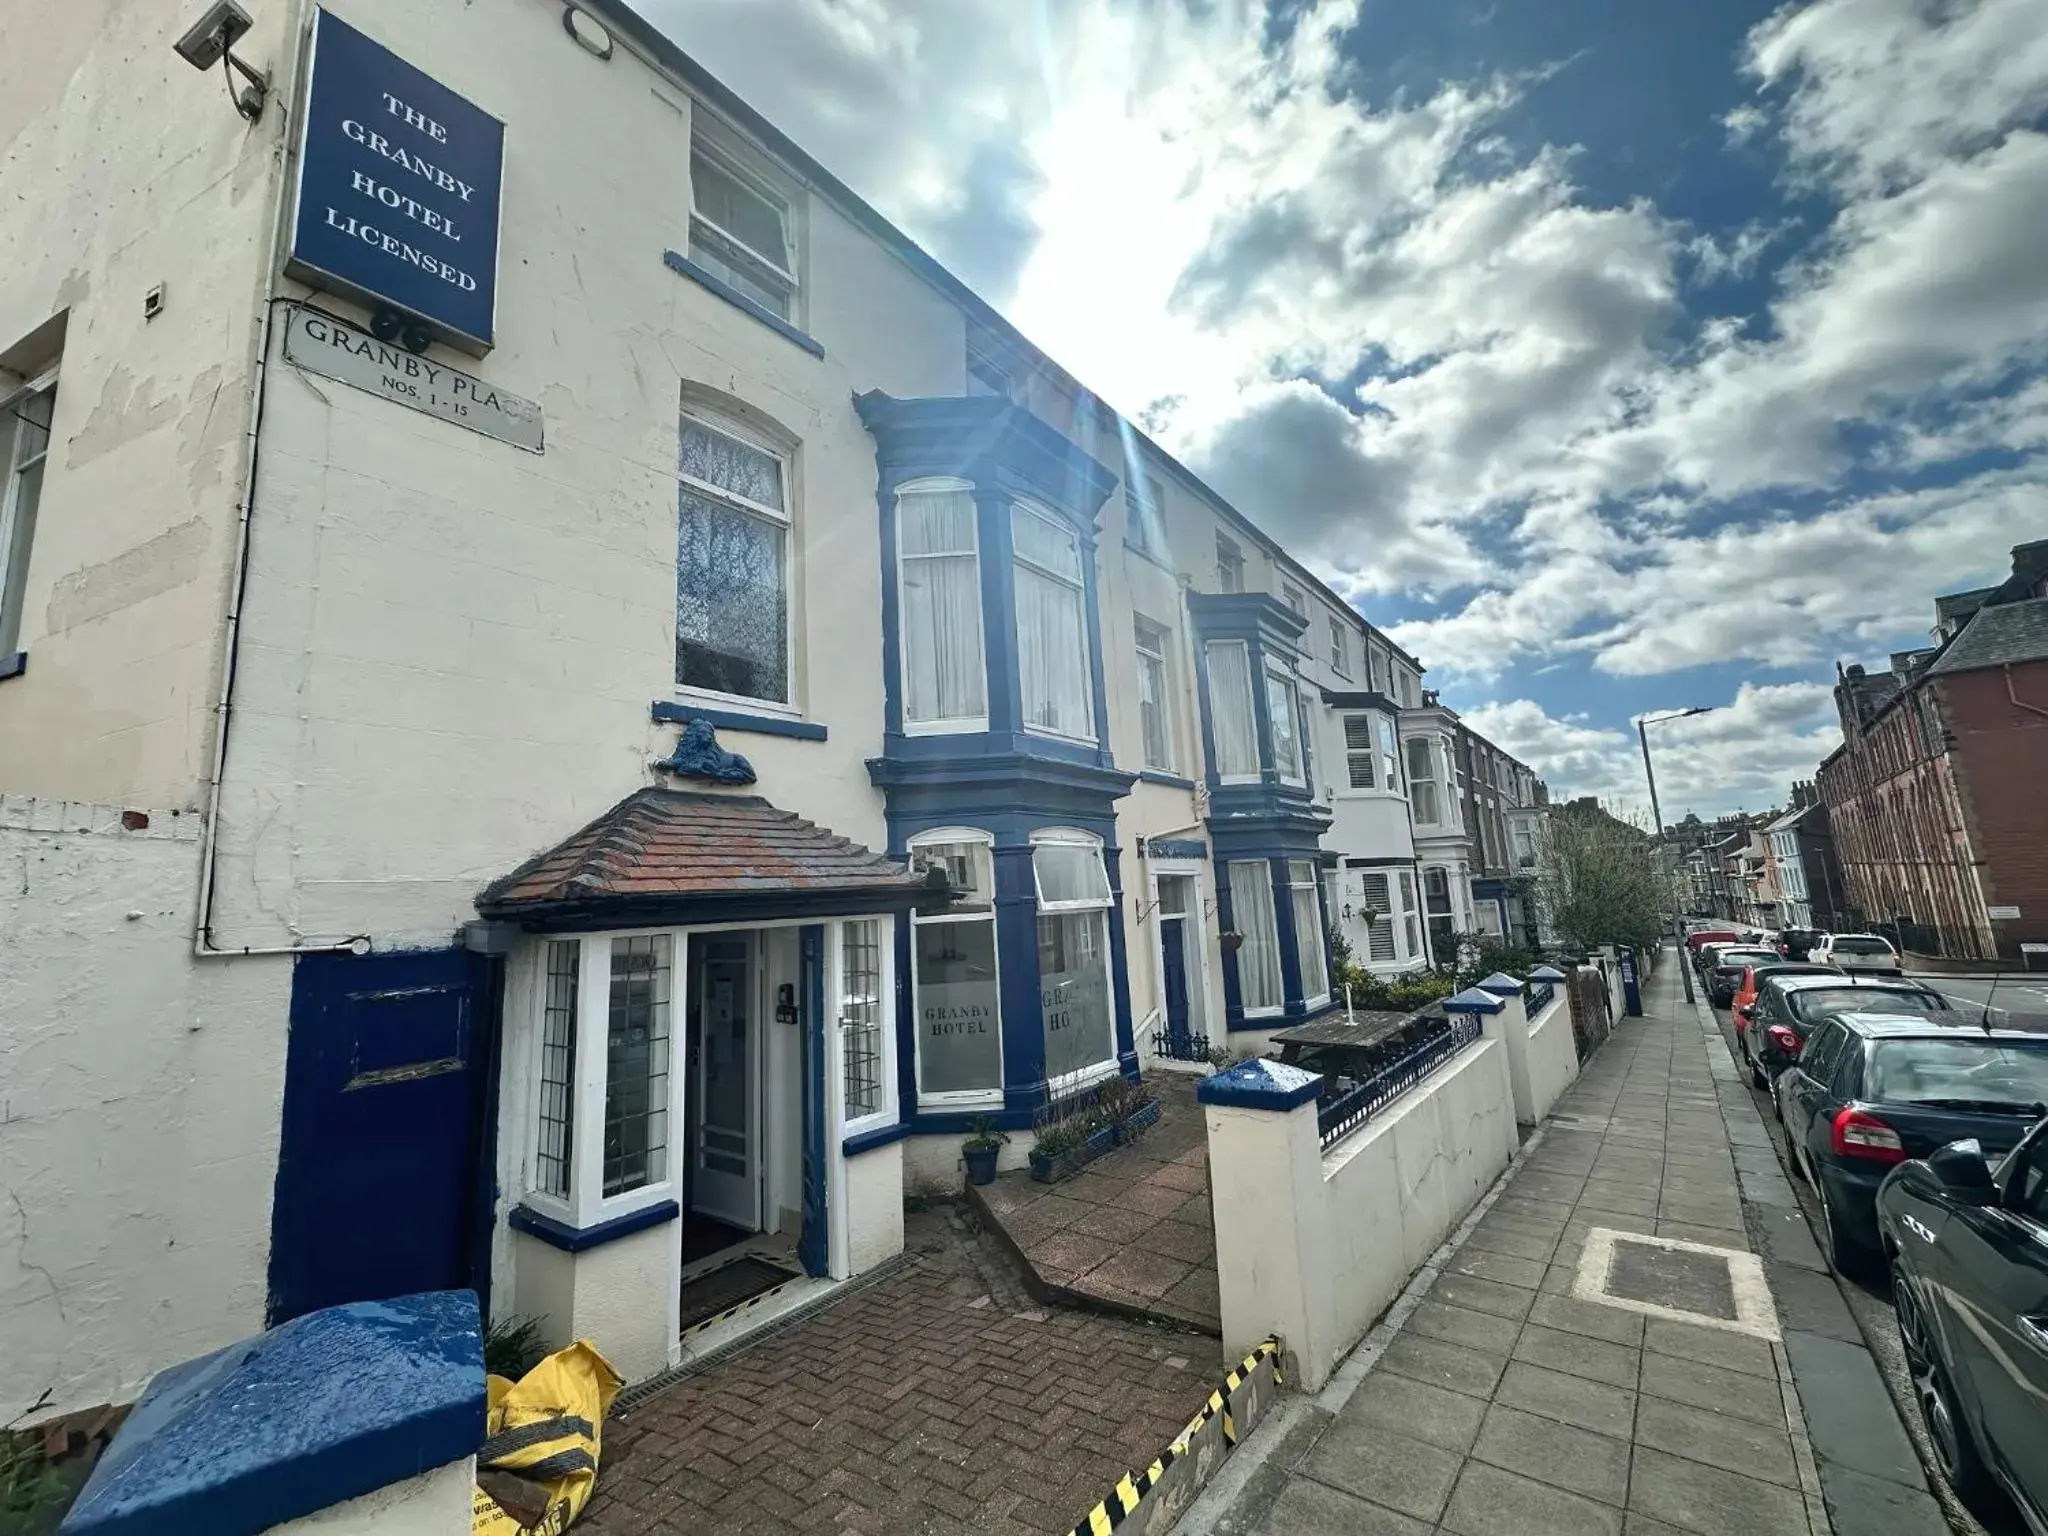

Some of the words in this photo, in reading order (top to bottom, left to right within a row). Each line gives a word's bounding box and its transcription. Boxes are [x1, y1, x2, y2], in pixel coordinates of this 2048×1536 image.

[383, 93, 447, 144] THE
[342, 119, 476, 203] GRANBY
[351, 169, 462, 242] HOTEL
[325, 207, 477, 291] LICENSED
[305, 319, 441, 385] GRANBY
[382, 374, 422, 400] NOS.
[925, 1006, 990, 1019] GRANBY
[930, 1021, 987, 1036] HOTEL
